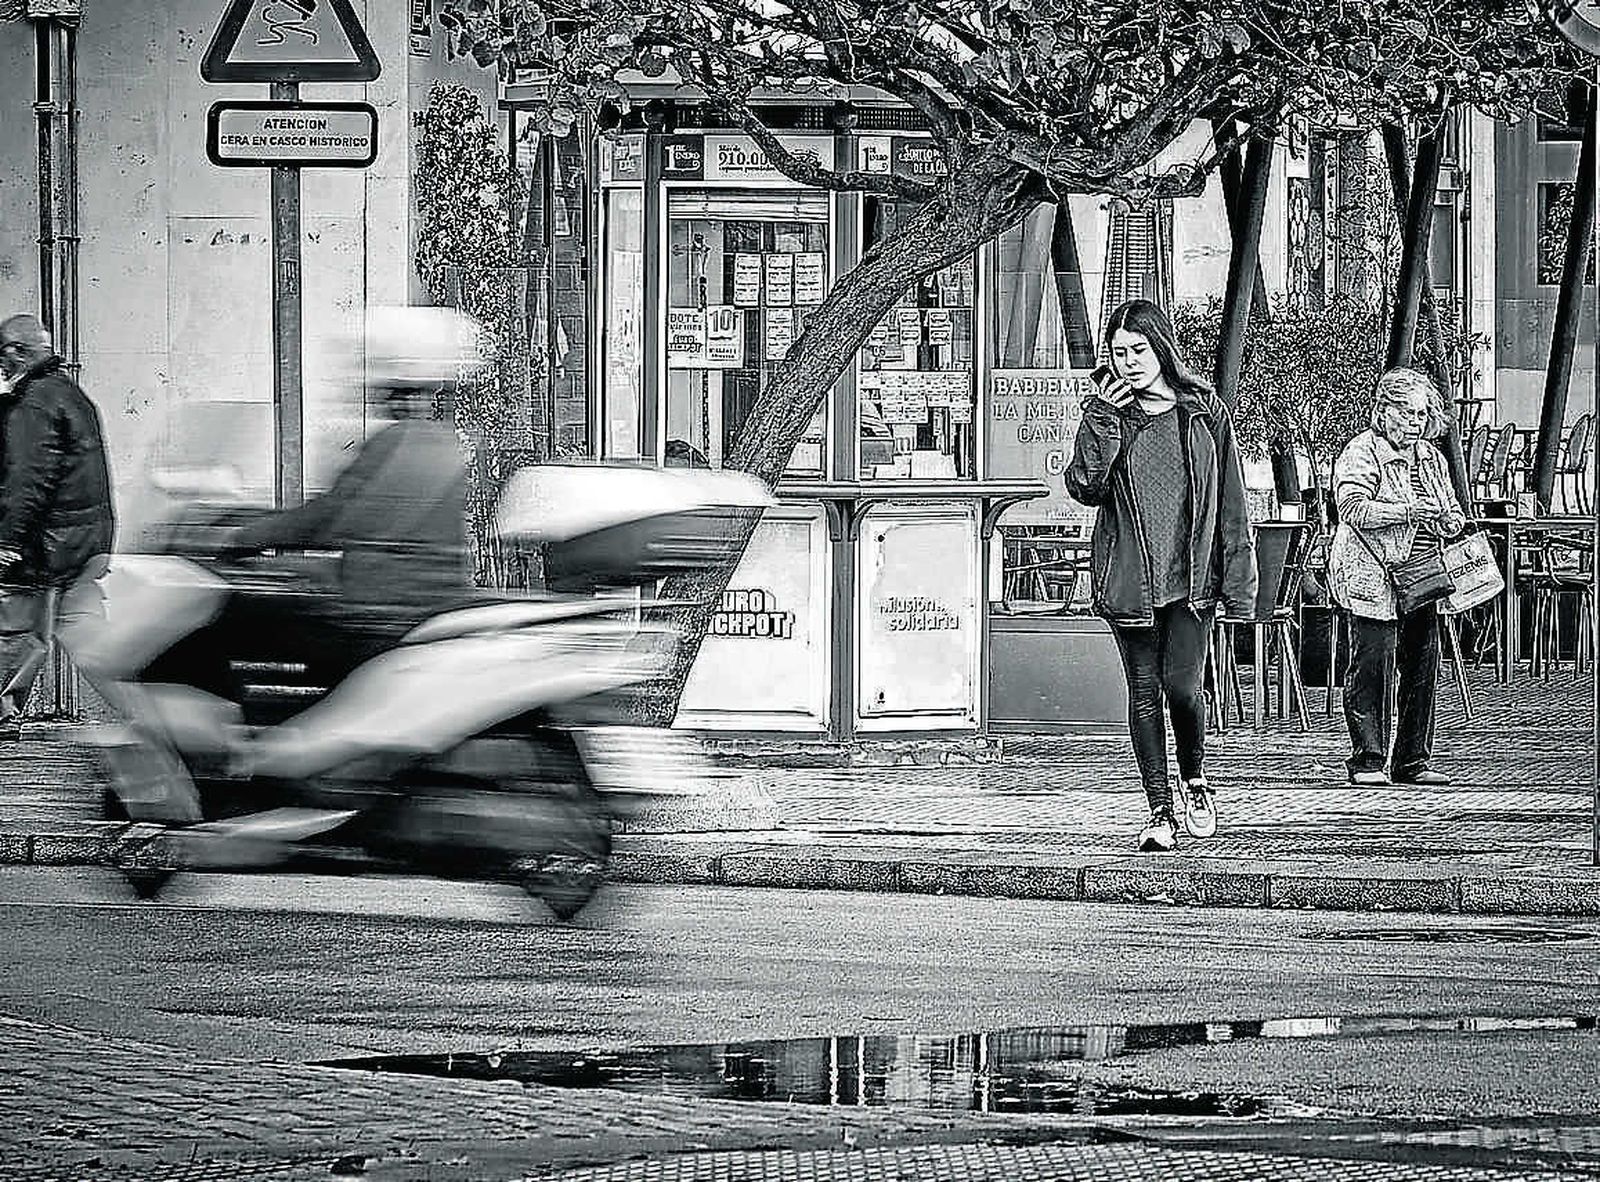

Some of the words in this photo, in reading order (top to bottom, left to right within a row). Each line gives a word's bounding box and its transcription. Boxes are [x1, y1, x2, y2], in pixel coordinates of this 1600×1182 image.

[263, 118, 327, 130] ATENCION
[220, 135, 250, 146] CERA
[253, 136, 267, 146] EN
[269, 136, 306, 147] CASCO
[309, 136, 369, 147] HISTORICO
[718, 152, 774, 166] 910.00
[995, 377, 1092, 395] BABLEME
[993, 402, 1018, 420] LA
[1026, 402, 1081, 420] MEJO
[1018, 422, 1075, 443] CAÑA
[706, 612, 788, 637] CKPOT
[888, 613, 959, 631] solidaria
